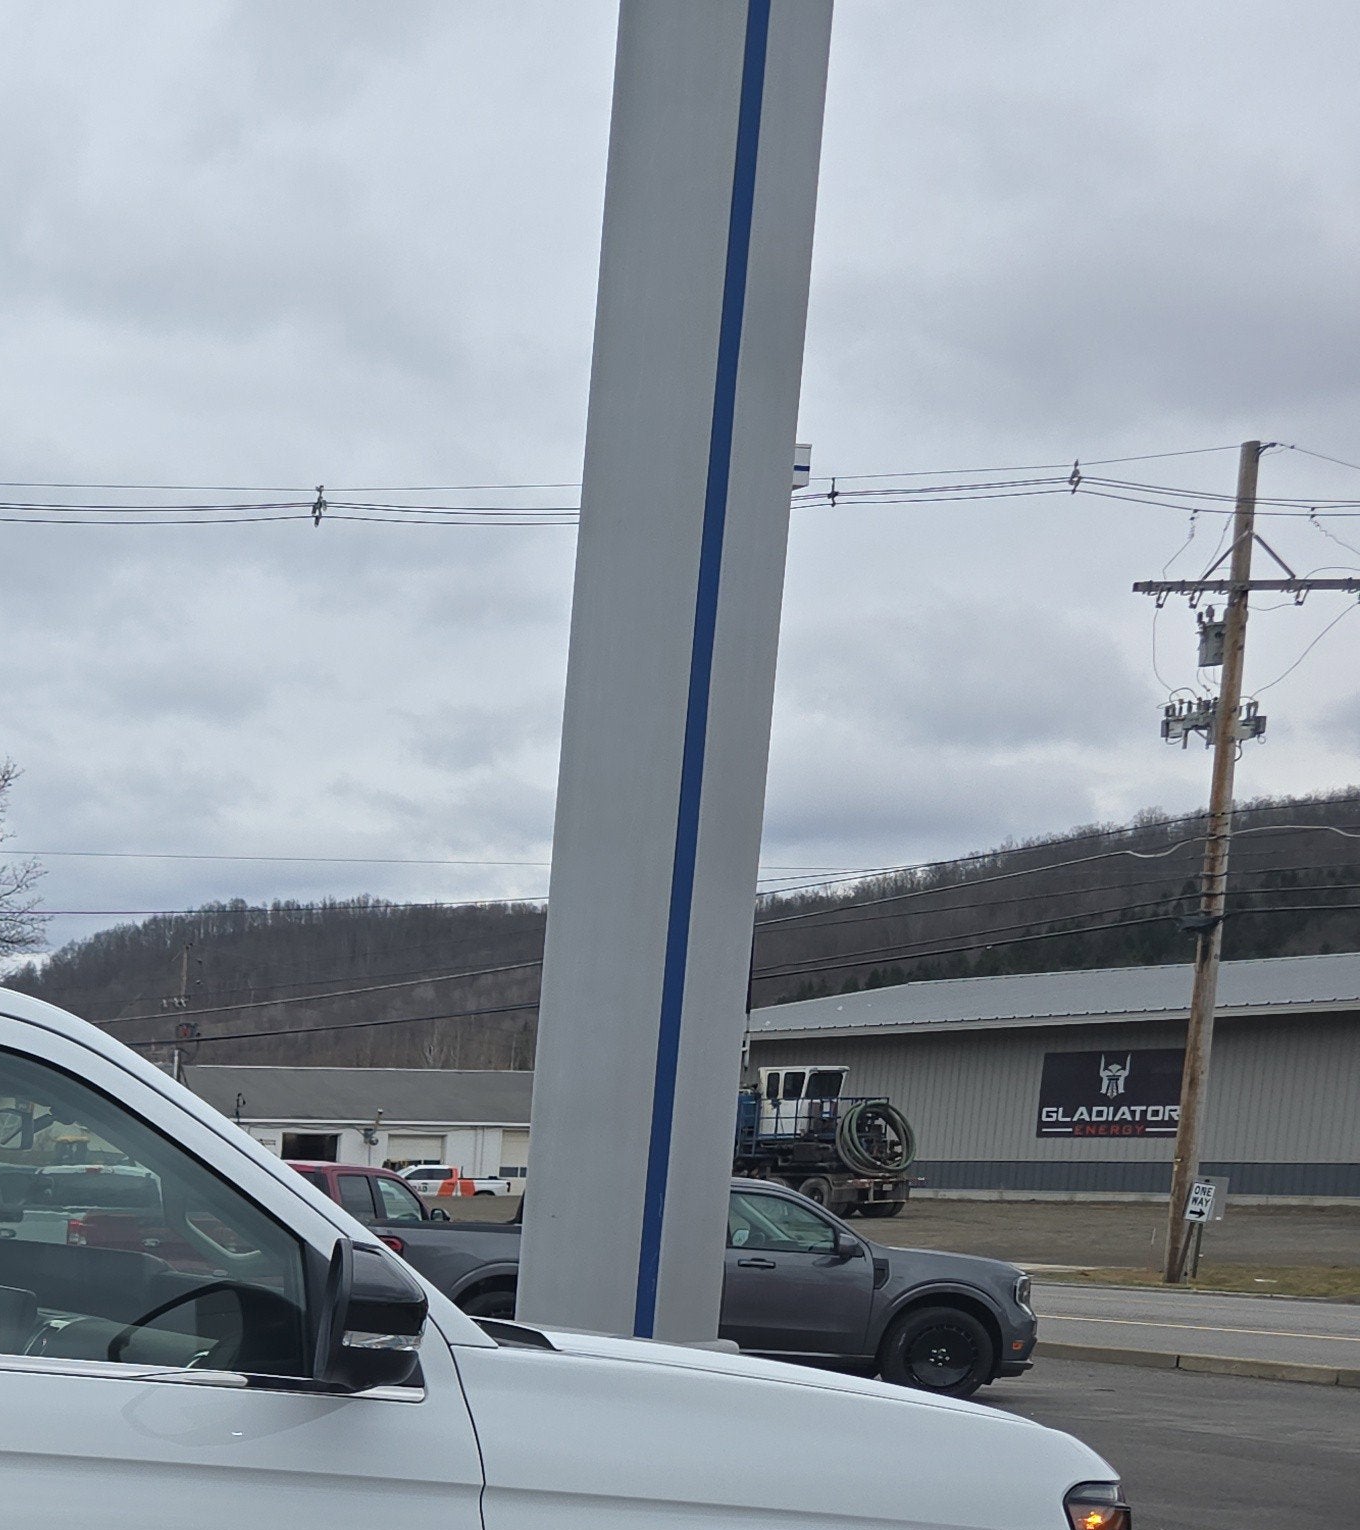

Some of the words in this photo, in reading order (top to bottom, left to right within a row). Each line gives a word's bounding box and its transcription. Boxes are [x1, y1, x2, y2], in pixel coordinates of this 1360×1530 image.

[1041, 1105, 1181, 1122] GLADIATOR
[1074, 1124, 1145, 1136] ENERGY
[1194, 1185, 1213, 1197] ONE
[1191, 1196, 1211, 1207] WAY
